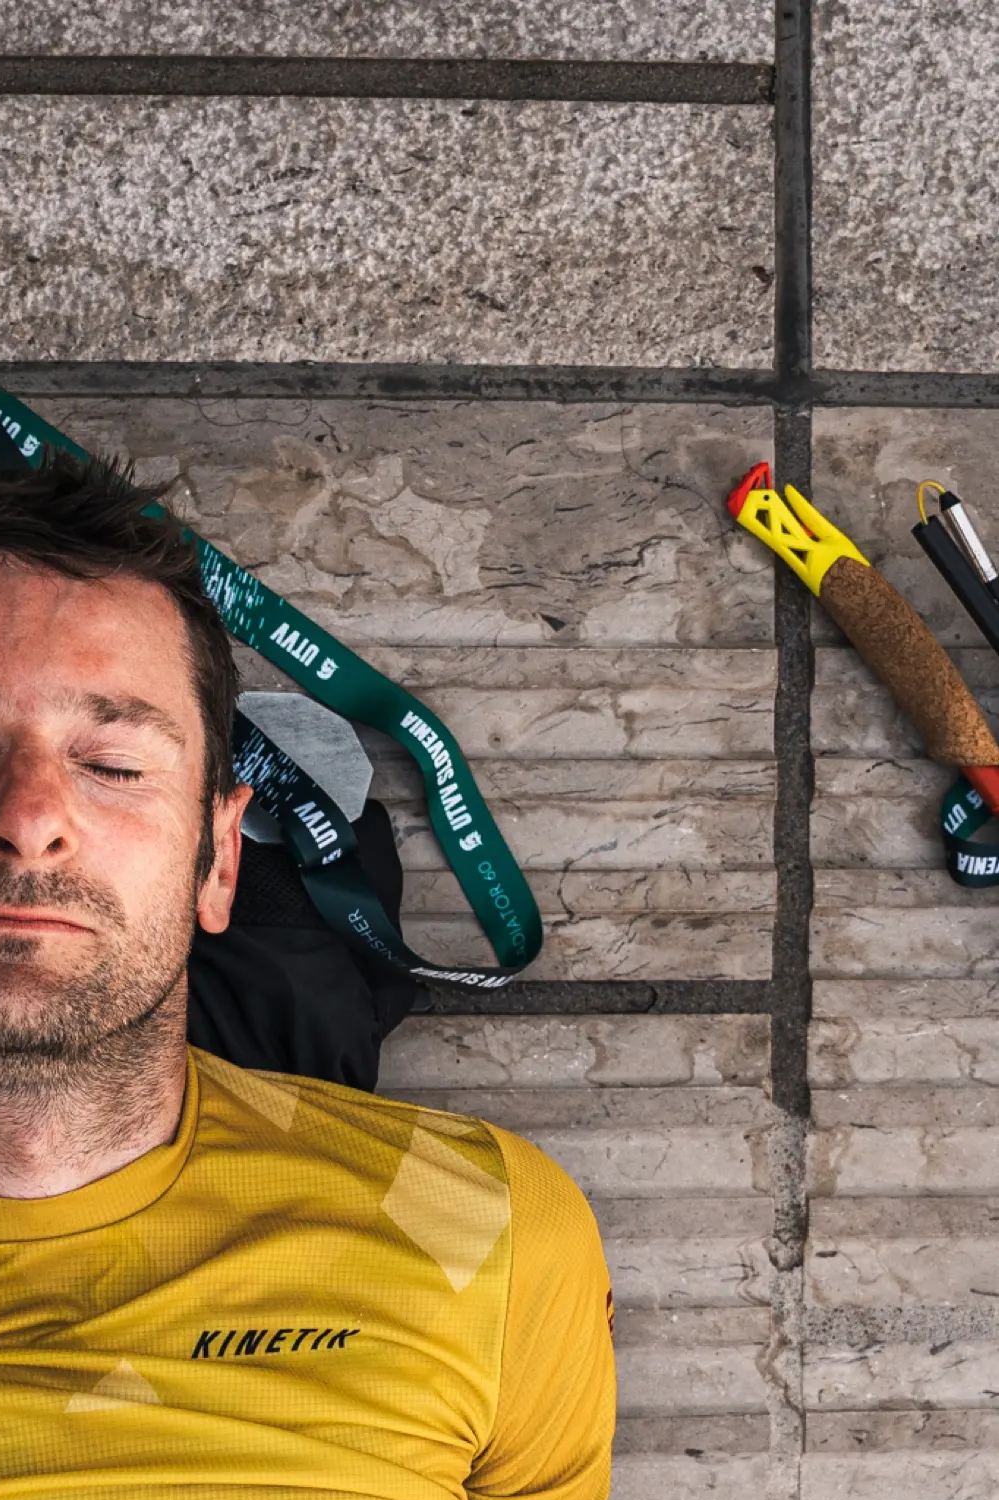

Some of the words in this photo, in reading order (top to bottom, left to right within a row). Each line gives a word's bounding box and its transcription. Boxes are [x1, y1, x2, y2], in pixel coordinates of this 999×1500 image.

[269, 621, 320, 668] UTVV
[400, 710, 455, 786] SLOVENIA
[292, 800, 339, 850] UTVV
[439, 782, 474, 832] UTVV
[957, 852, 999, 876] ENIA
[348, 908, 402, 964] NISHER
[191, 1328, 362, 1359] KINETIK
